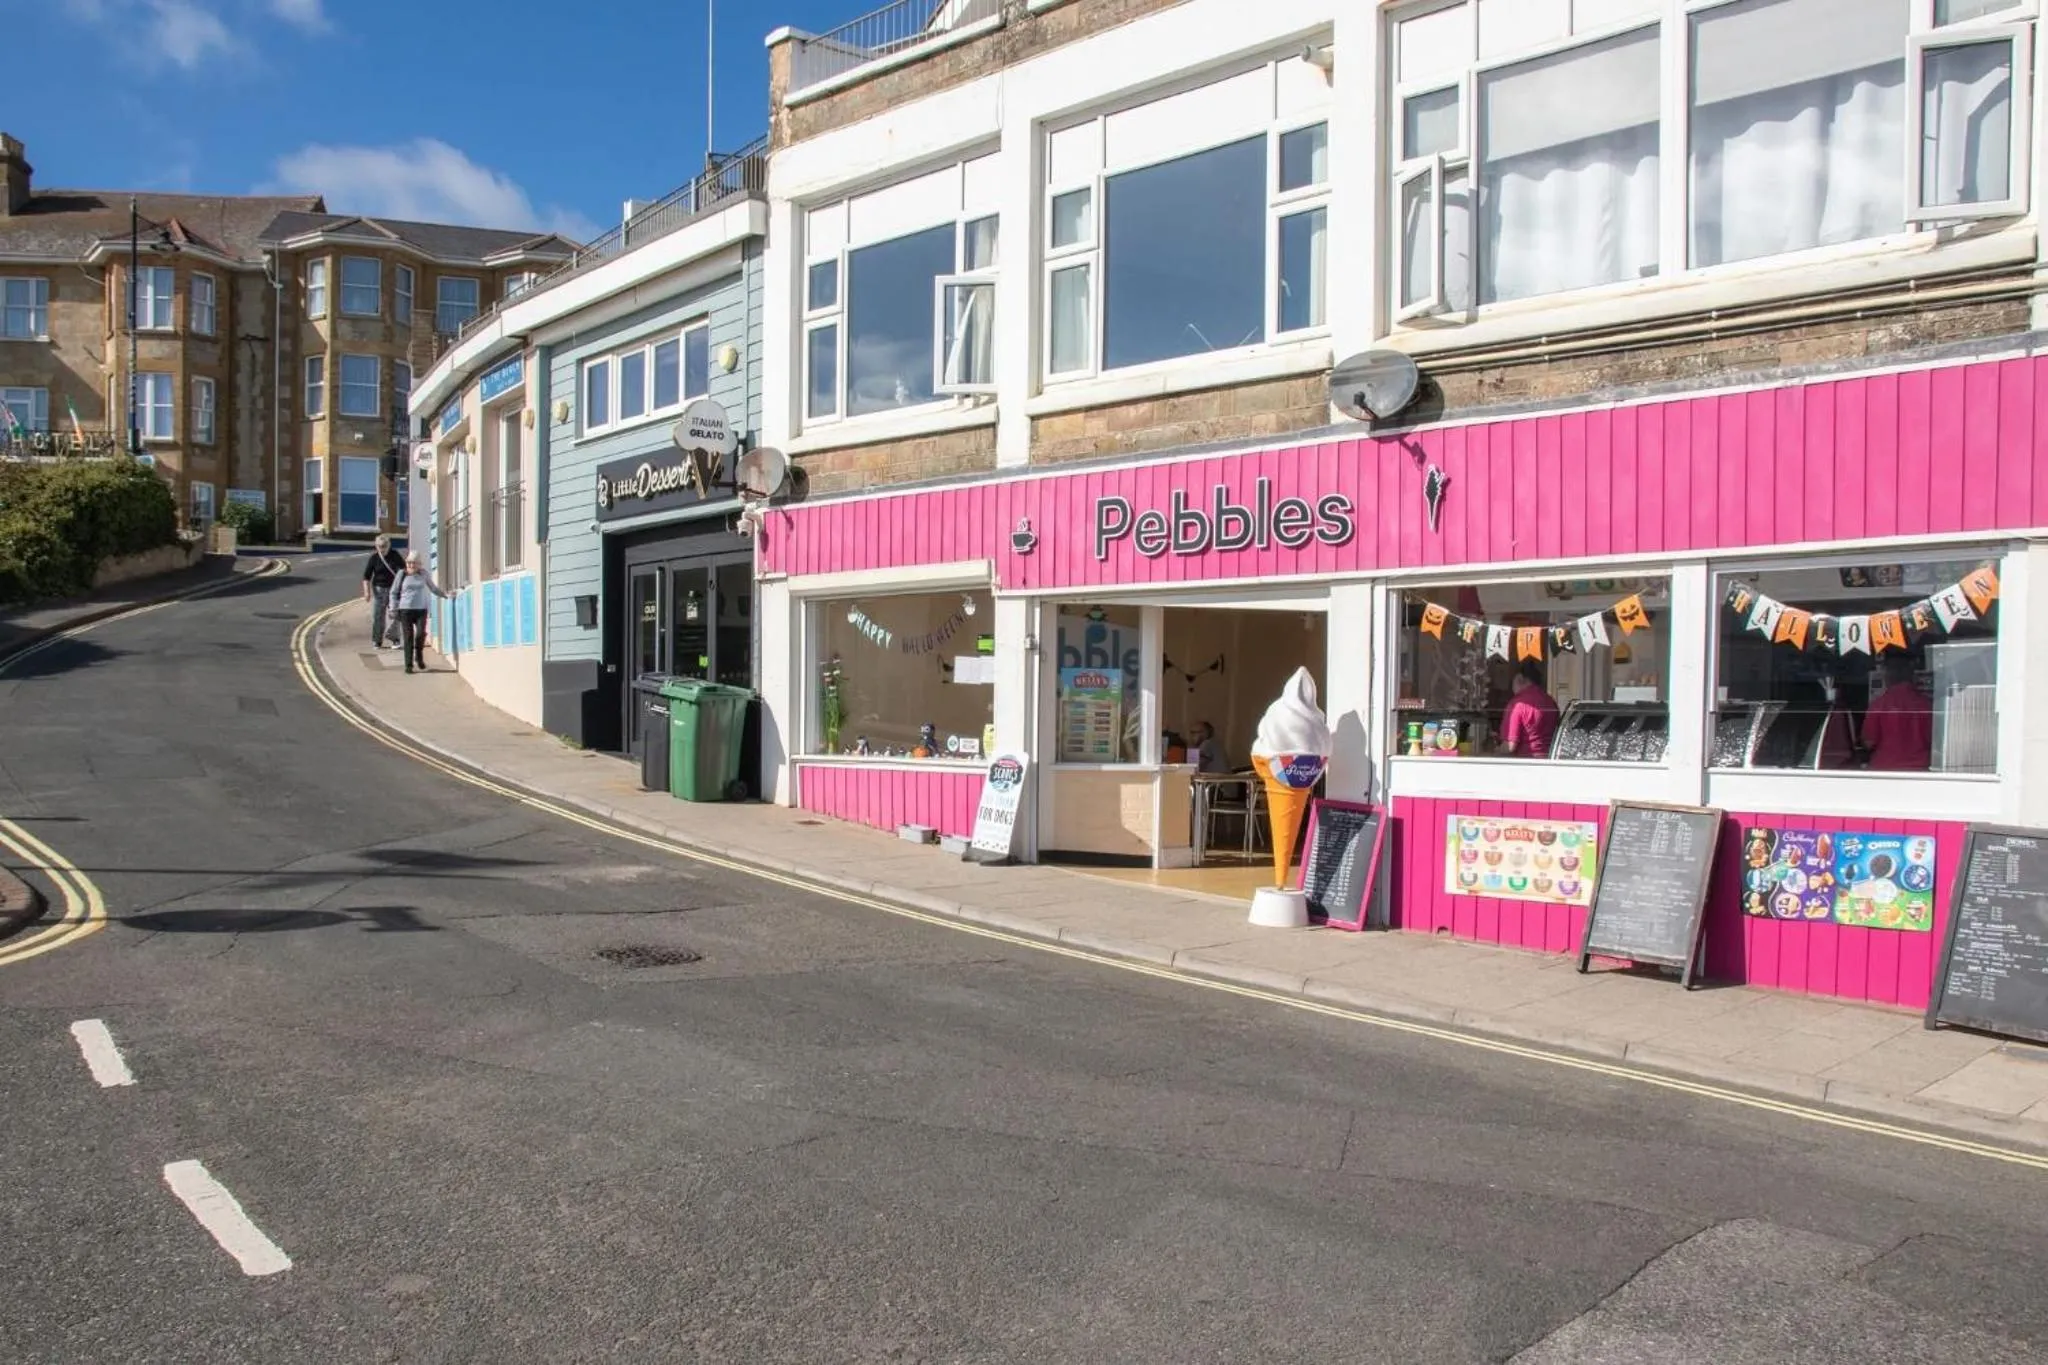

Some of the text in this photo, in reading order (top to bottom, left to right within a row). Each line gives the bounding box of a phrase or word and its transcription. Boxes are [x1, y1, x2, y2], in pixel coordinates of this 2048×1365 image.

[689, 428, 725, 441] GELATO
[691, 417, 723, 429] ITALIAN
[12, 432, 100, 452] HOTEL
[636, 453, 692, 498] Dessert
[1094, 476, 1355, 560] Pebbles
[1732, 576, 1994, 643] HALLOWEEN
[856, 613, 893, 649] HAPPY
[1462, 618, 1598, 650] HAPPY
[1782, 830, 1816, 843] Cadbury
[1867, 840, 1901, 851] OREO
